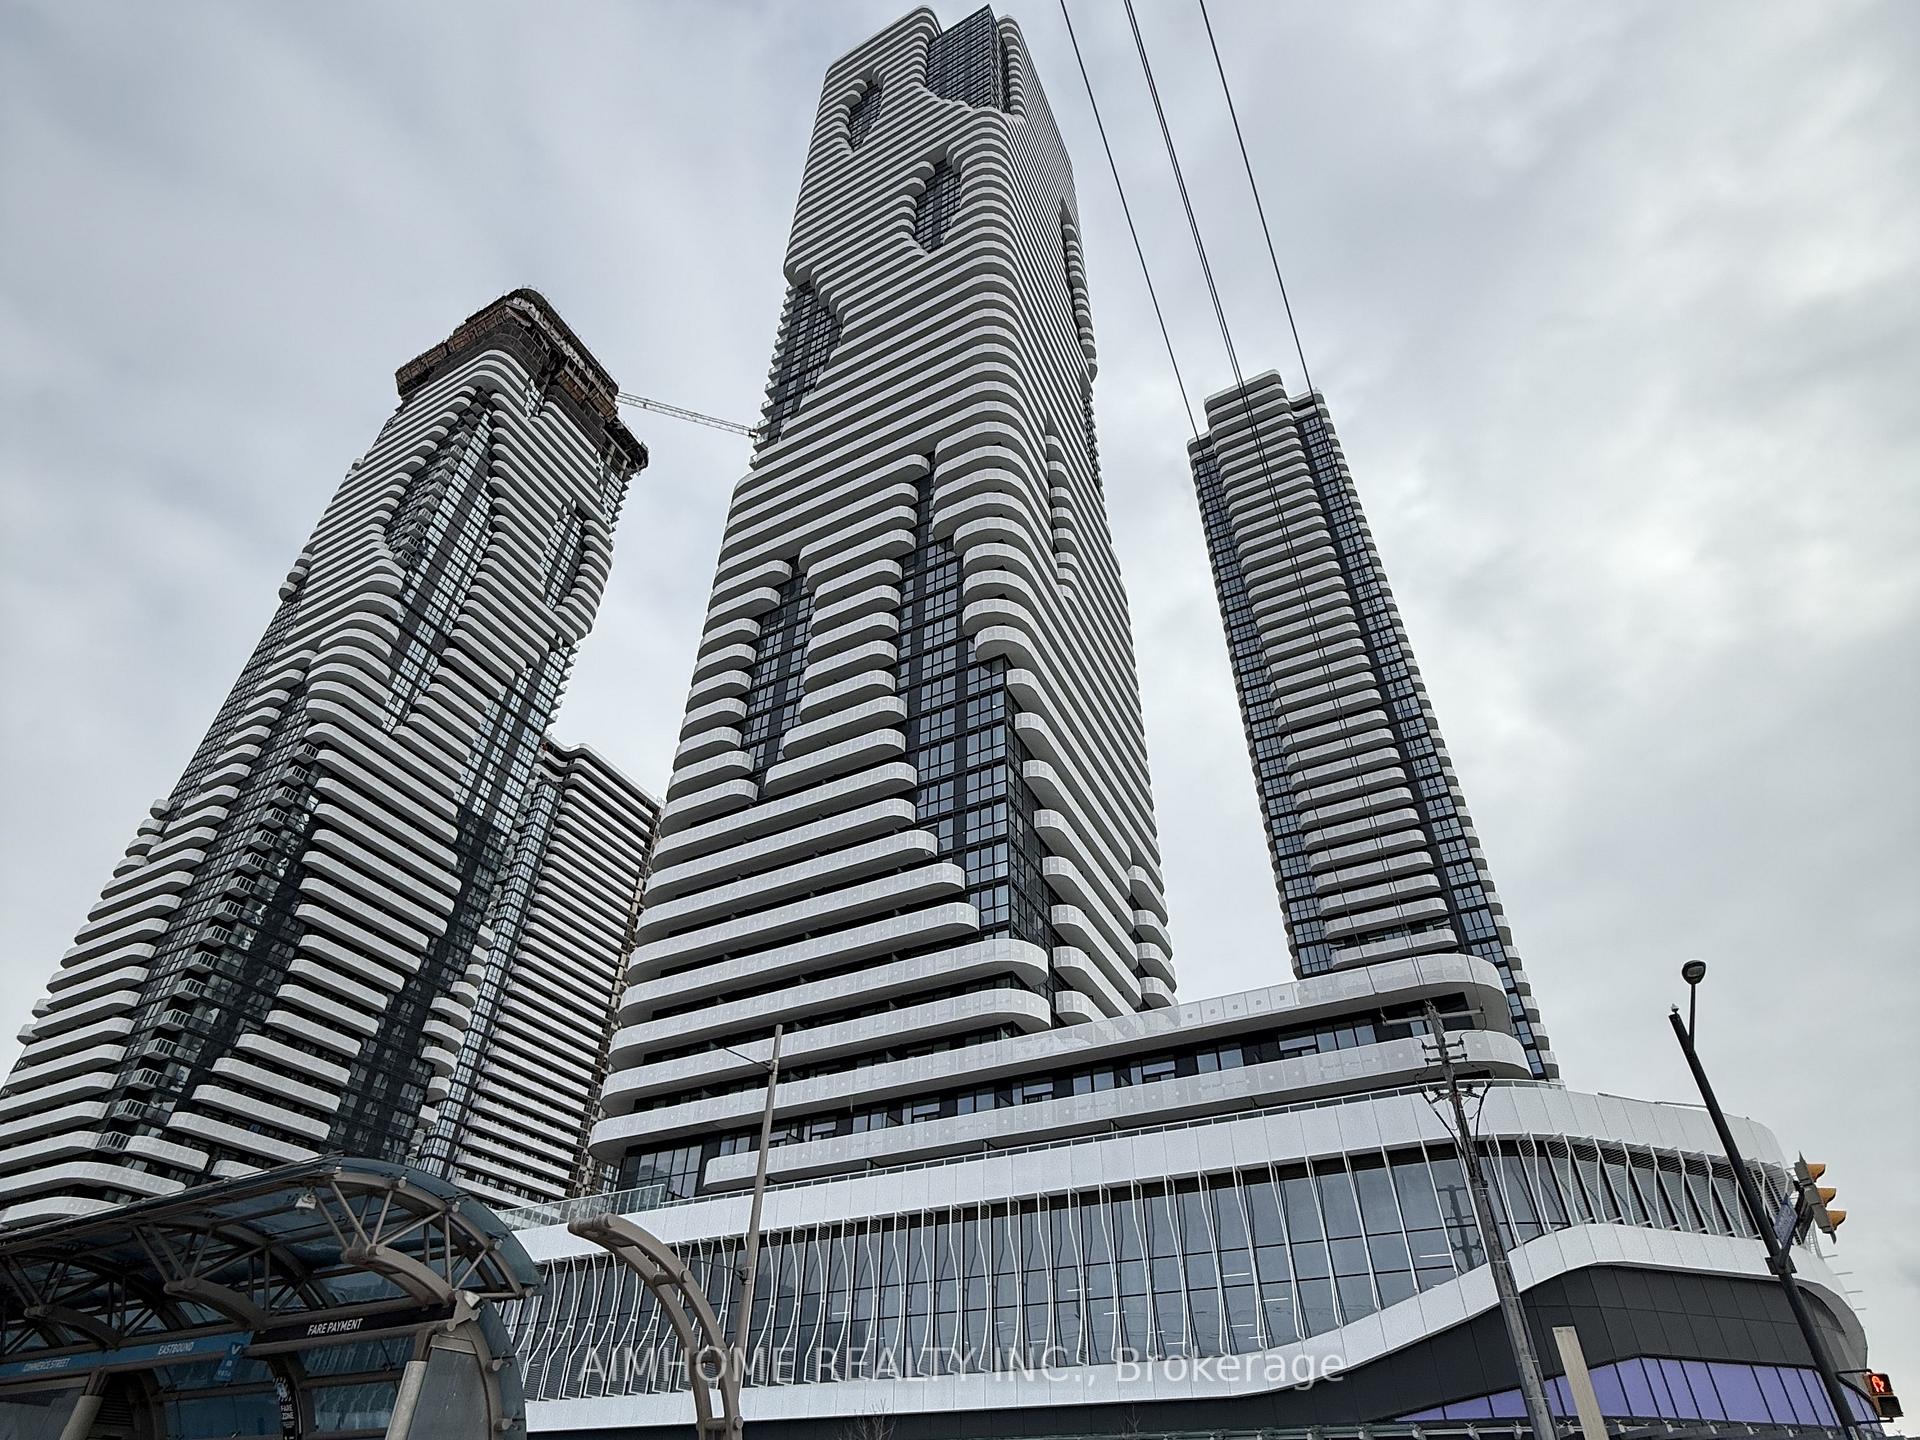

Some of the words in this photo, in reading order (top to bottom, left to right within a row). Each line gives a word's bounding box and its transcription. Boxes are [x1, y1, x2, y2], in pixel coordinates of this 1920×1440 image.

[307, 1323, 328, 1336] FARE
[327, 1318, 364, 1333] PAYMENT
[157, 1341, 195, 1355] EASTBOUND
